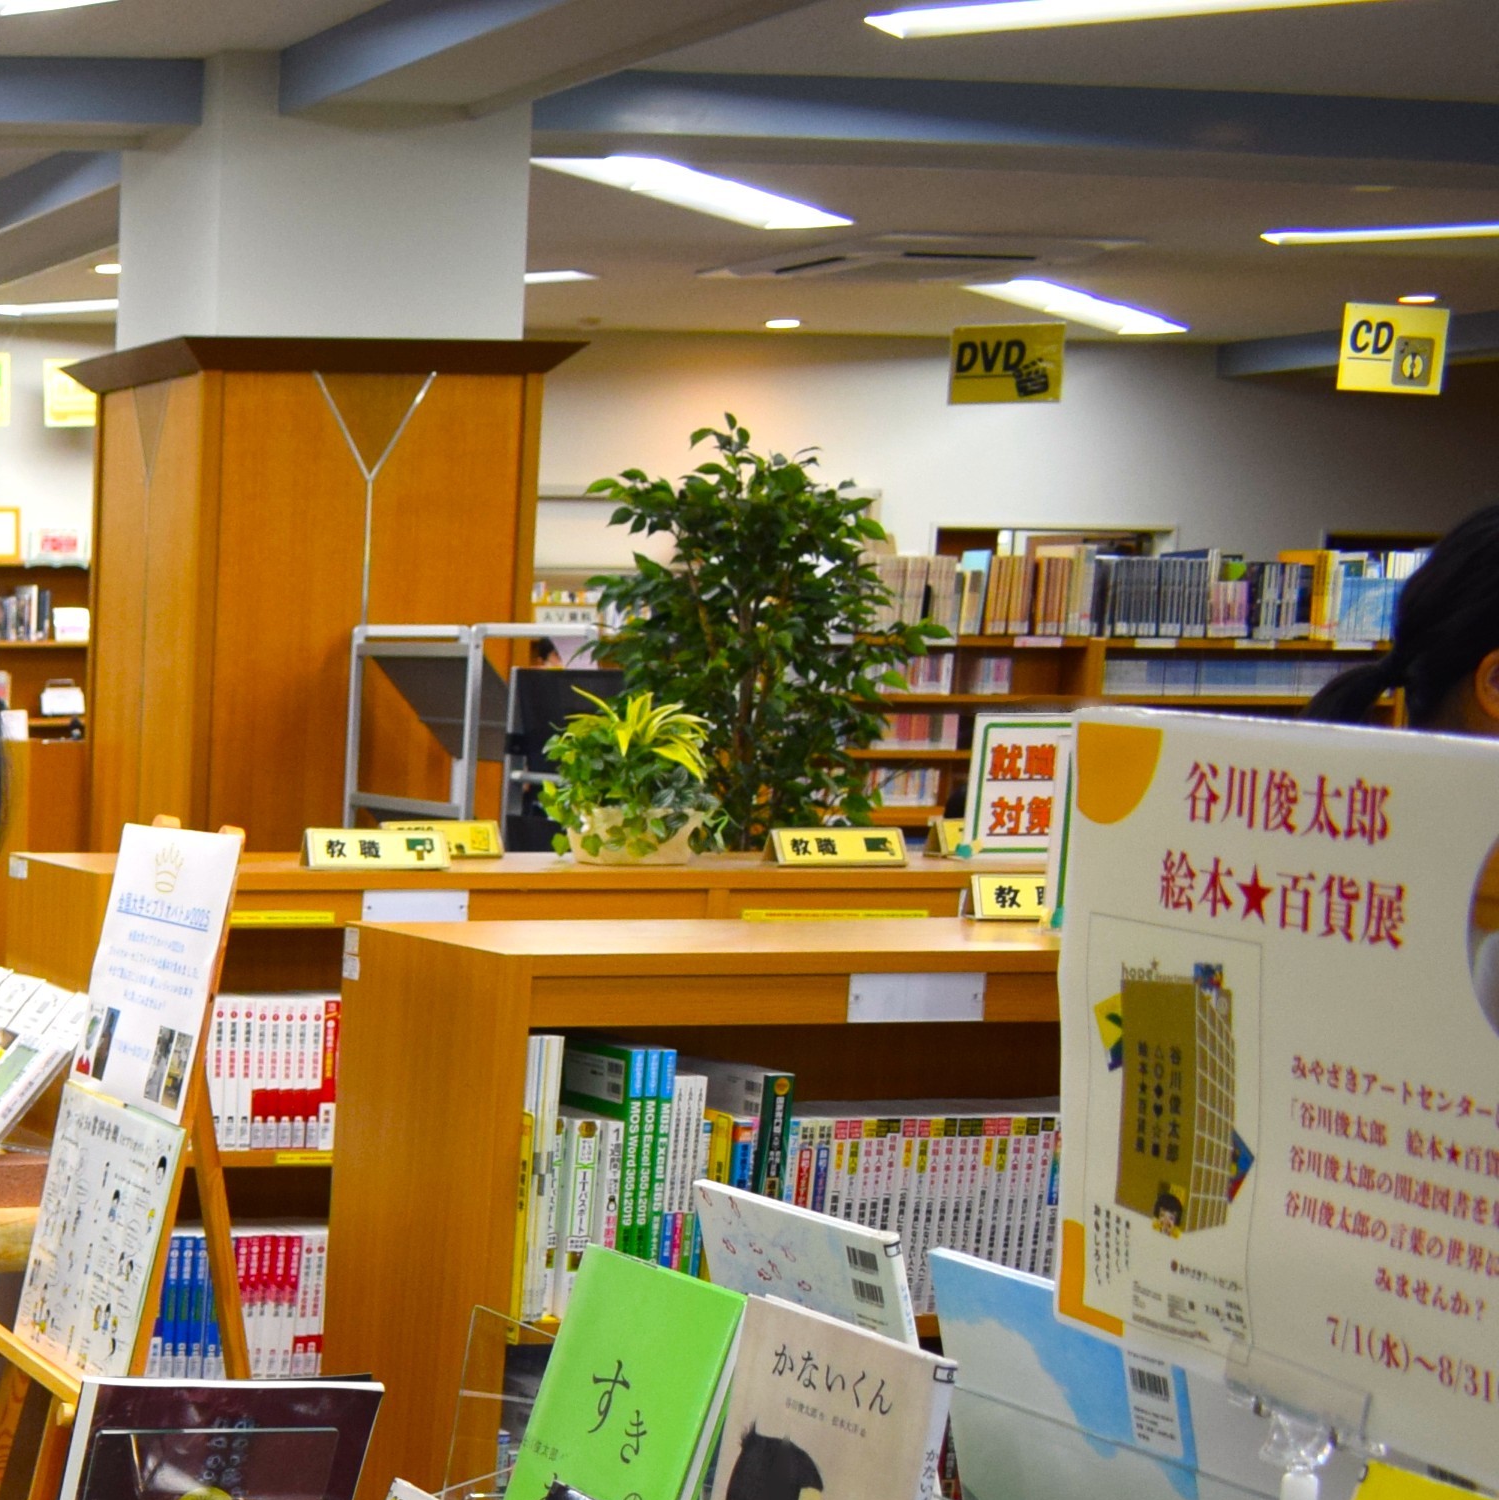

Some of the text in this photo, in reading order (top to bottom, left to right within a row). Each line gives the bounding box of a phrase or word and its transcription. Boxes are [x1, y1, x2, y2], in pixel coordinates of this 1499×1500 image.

[955, 339, 1027, 374] DVD
[1348, 319, 1394, 357] CD
[988, 743, 1057, 780] 就職
[988, 796, 1052, 836] 対策
[1185, 760, 1391, 846] 谷川俊太郎
[326, 839, 382, 859] 教職
[790, 837, 838, 856] 教職
[1159, 849, 1407, 950] 絵本★百貨展
[1168, 1045, 1182, 1164] 谷川俊太郎
[1290, 1054, 1499, 1130] みやざきアートセンター
[643, 1100, 657, 1133] MOS
[658, 1102, 672, 1135] MOS
[621, 1100, 642, 1227] MOS Word 365&2019
[642, 1135, 655, 1168] Excel
[654, 1136, 670, 1180] Excel
[576, 1170, 590, 1235] ITパスポート
[1374, 1267, 1487, 1323] みませんか？
[771, 1343, 895, 1417] かないくん
[1325, 1315, 1499, 1404] 7/1(水)～8/31
